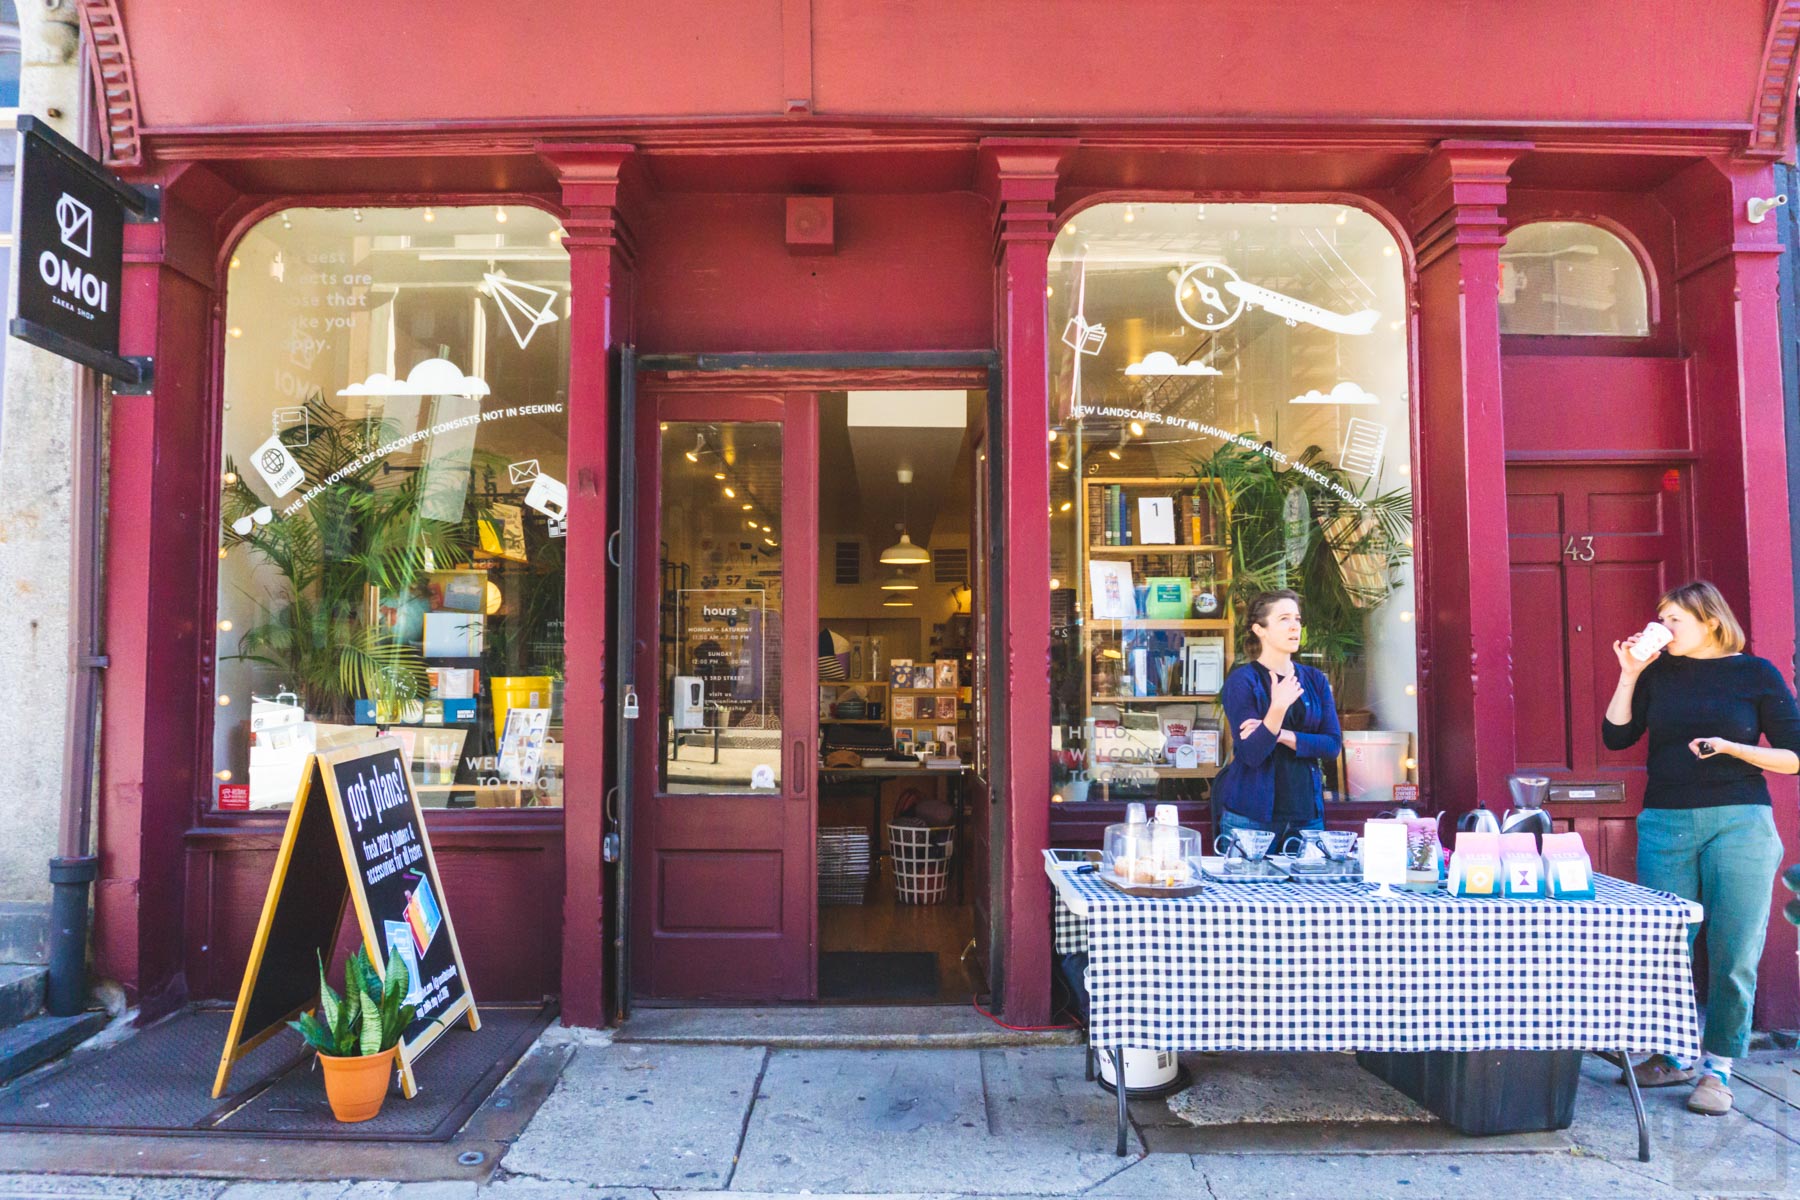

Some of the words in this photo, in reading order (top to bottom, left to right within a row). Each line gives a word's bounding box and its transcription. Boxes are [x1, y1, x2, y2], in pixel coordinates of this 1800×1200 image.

[39, 250, 108, 313] OMOI
[343, 274, 373, 285] are
[1206, 266, 1214, 279] N
[52, 295, 75, 312] ZAKKA
[77, 307, 95, 320] SHOP
[326, 292, 367, 307] that
[325, 317, 357, 332] you
[1206, 313, 1214, 324] S
[283, 501, 304, 517] THE
[302, 485, 327, 504] REAL
[324, 459, 363, 487] VOYAGE
[362, 452, 377, 465] OF
[376, 429, 431, 458] DISCOVERY
[431, 414, 481, 435] CONSISTS
[482, 409, 504, 423] NOT
[506, 408, 518, 418] IN
[519, 403, 564, 415] SEEKING
[1072, 405, 1096, 415] NEW
[1096, 406, 1164, 425] LANDSCAPES,
[1166, 416, 1187, 428] BUT
[1187, 420, 1199, 432] IN
[1200, 424, 1238, 443] HAVING
[1238, 436, 1263, 453] NEW
[1262, 446, 1288, 465] EYES.
[1290, 461, 1330, 489] -MARCEL
[1330, 482, 1368, 511] PROUST
[273, 465, 298, 490] PASSPORT
[1564, 535, 1595, 562] 43
[703, 605, 737, 616] hours
[466, 756, 557, 771] WELOME
[1069, 747, 1161, 761] WLCOME
[477, 777, 500, 790] TO
[507, 777, 552, 791] OMO
[347, 772, 372, 832] got
[369, 757, 408, 824] plans?
[363, 838, 380, 861] fresh
[376, 832, 392, 855] 2022
[366, 855, 396, 885] accessories
